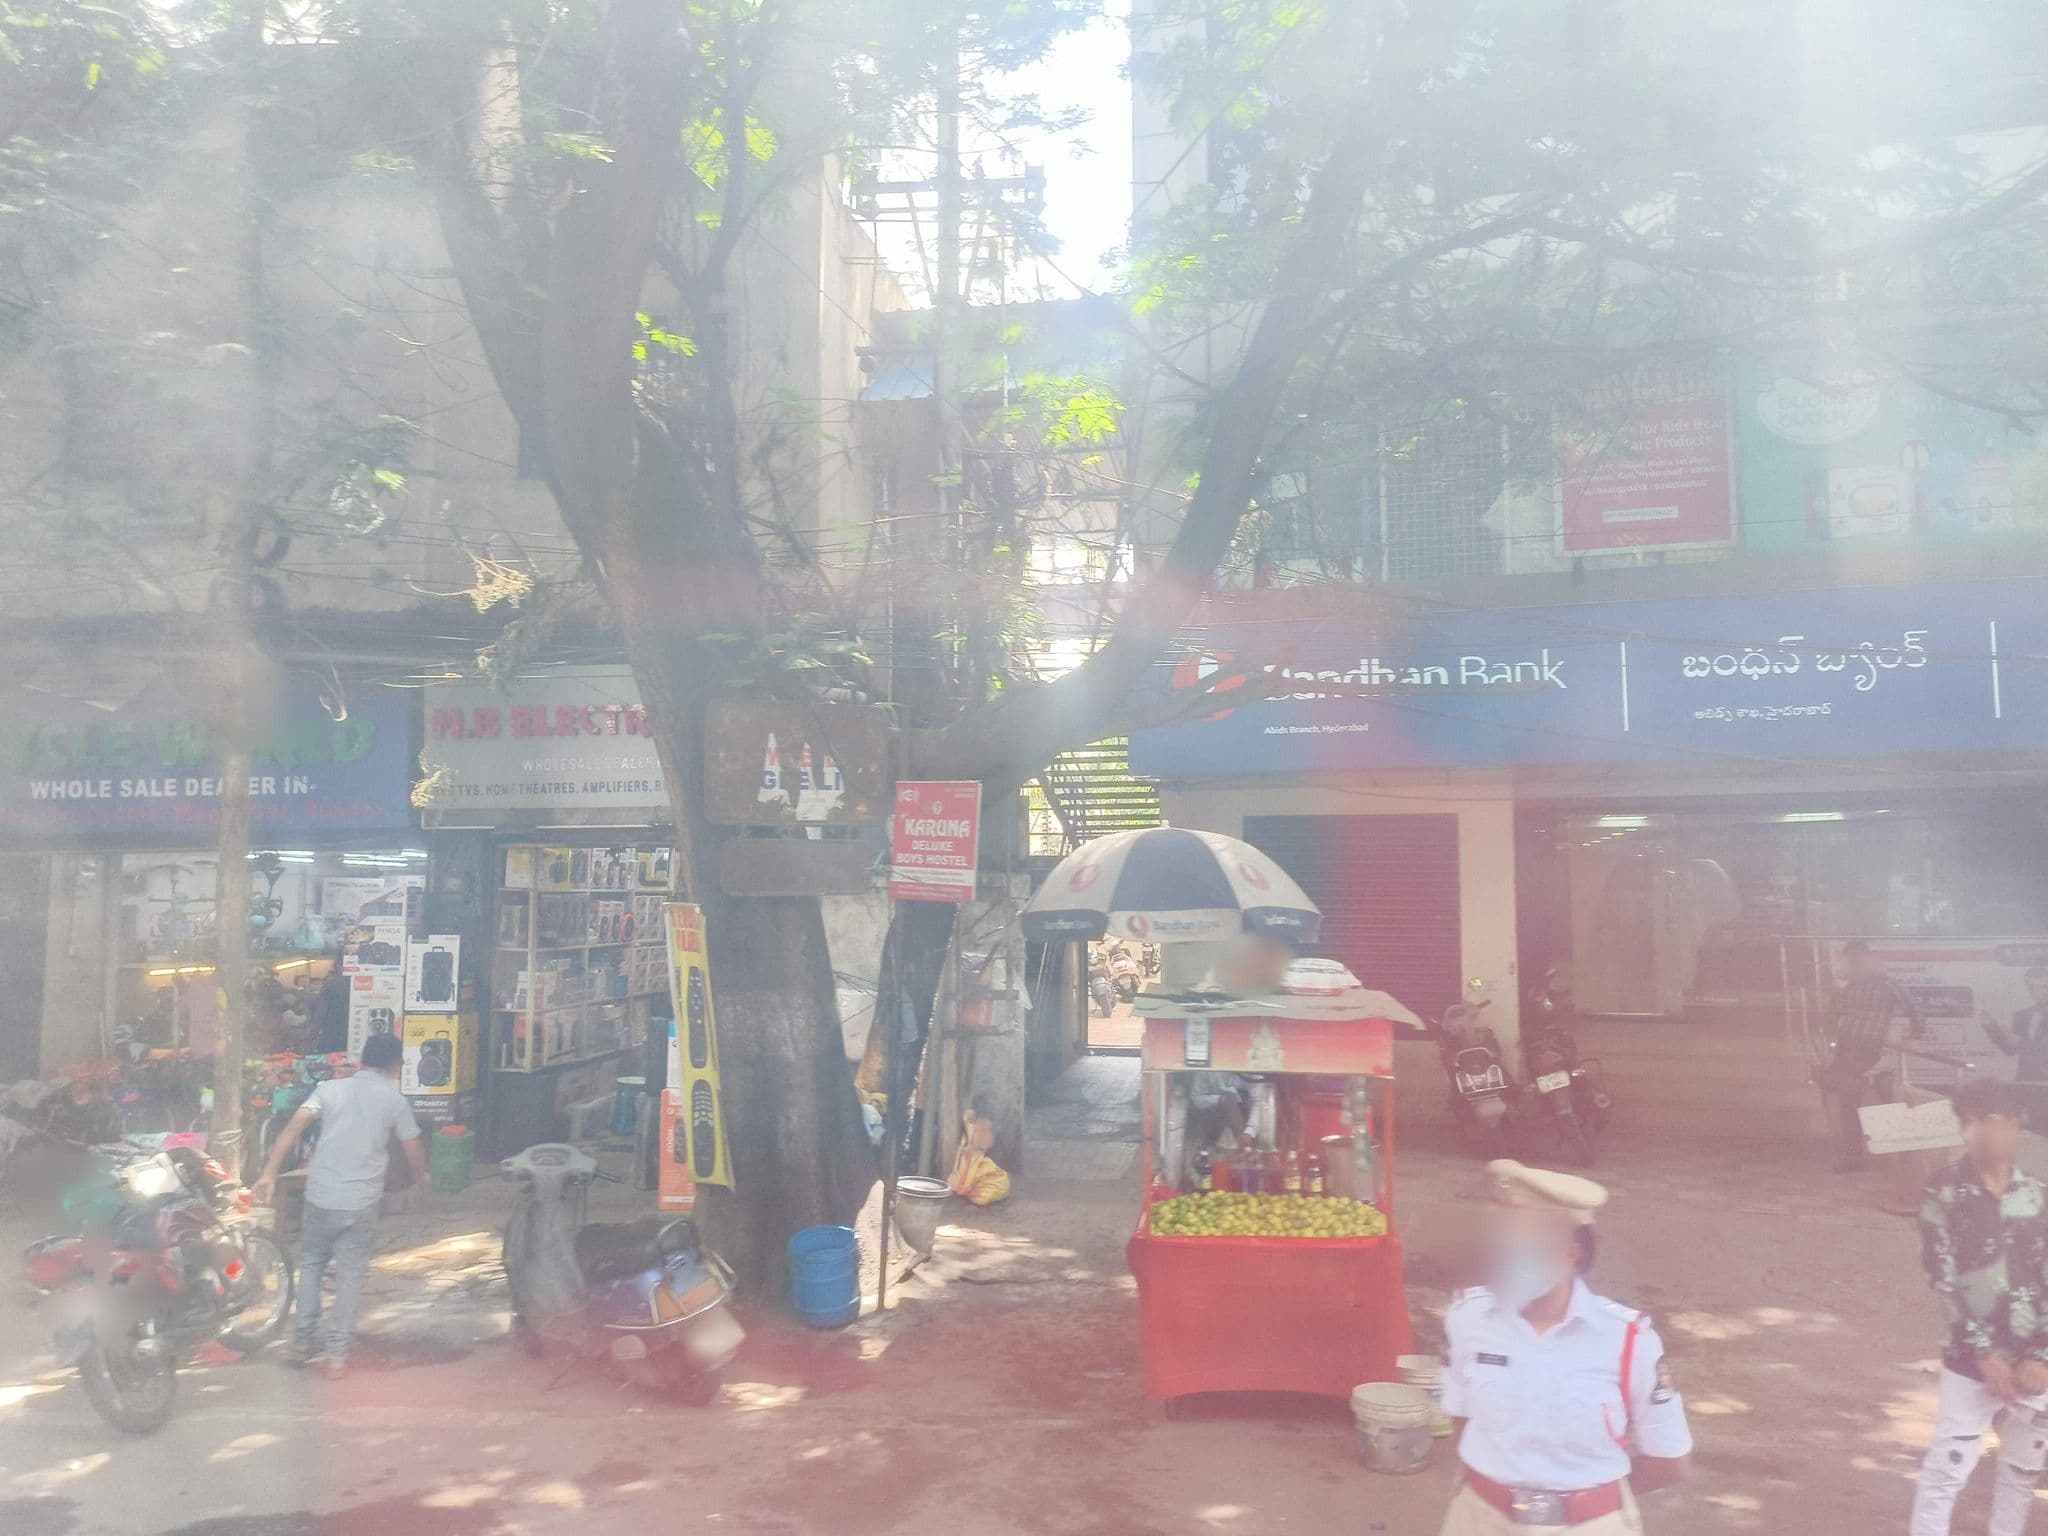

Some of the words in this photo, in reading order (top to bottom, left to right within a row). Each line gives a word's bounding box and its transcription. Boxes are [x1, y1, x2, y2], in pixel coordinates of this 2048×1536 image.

[1461, 648, 1568, 689] Bank
[1682, 634, 1805, 681] బంధన్
[30, 779, 112, 799] WHOLE
[119, 778, 179, 798] SALE
[184, 776, 278, 797] DEAER
[904, 818, 970, 838] KARUNA
[926, 854, 969, 867] HOSTEL
